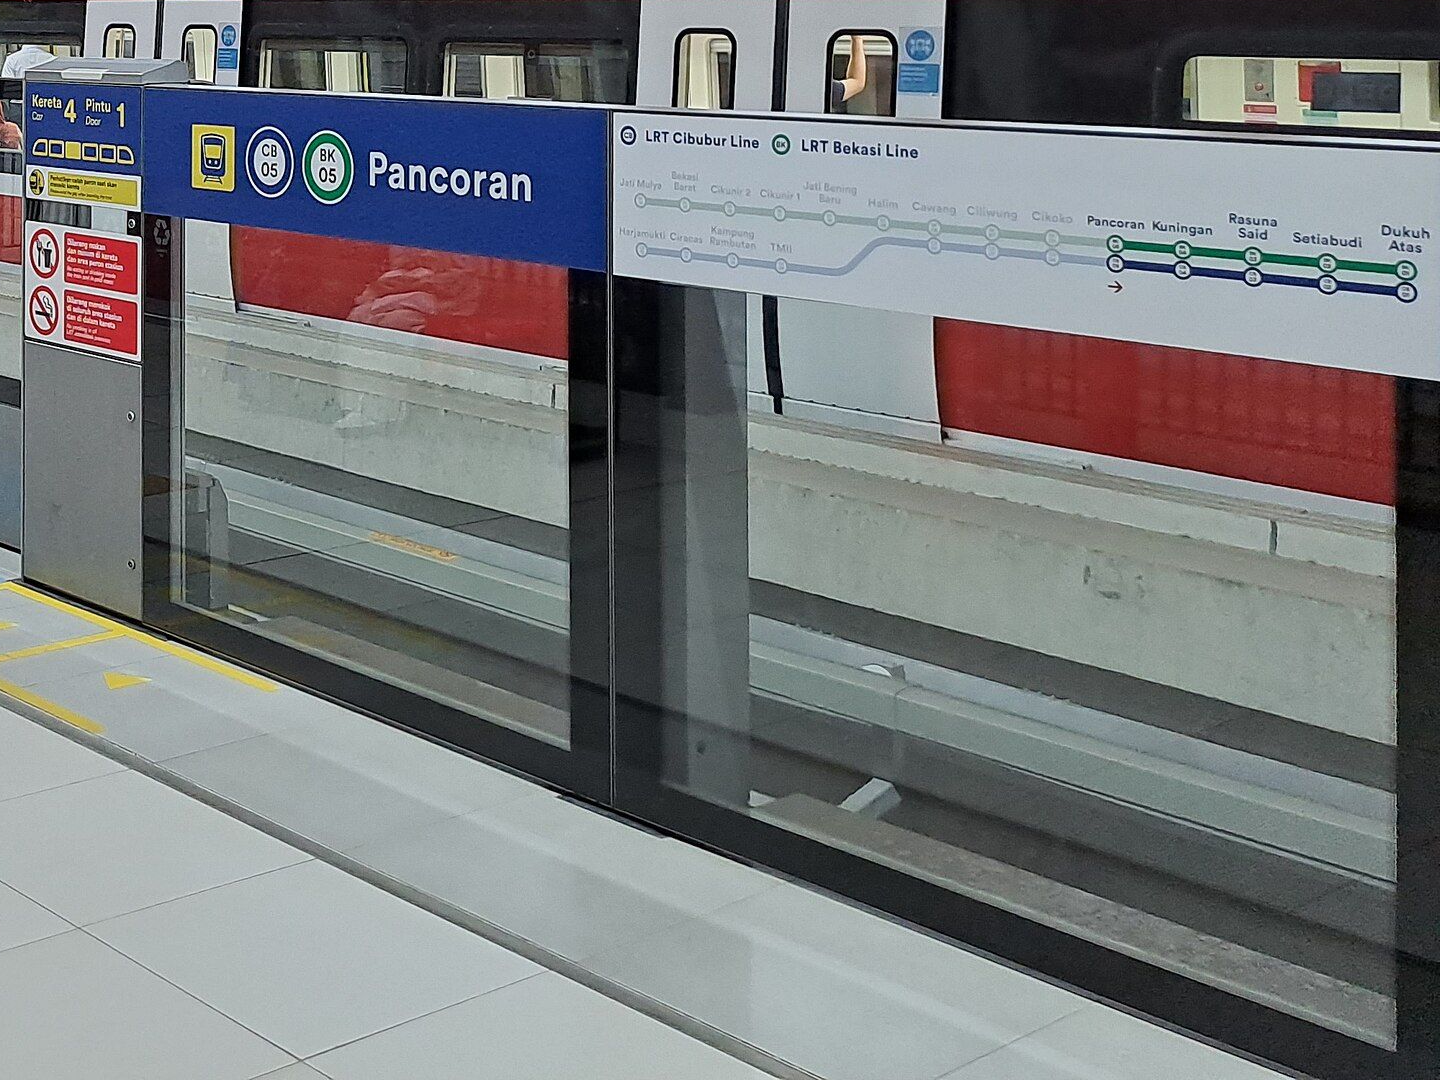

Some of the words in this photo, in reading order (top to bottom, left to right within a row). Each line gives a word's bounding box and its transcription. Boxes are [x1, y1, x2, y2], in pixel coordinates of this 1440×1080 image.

[32, 94, 62, 109] Kereta
[64, 99, 77, 123] 4
[85, 98, 111, 113] Pintu
[116, 102, 125, 128] 1
[32, 111, 44, 121] Car
[85, 115, 102, 126] Door
[262, 143, 278, 158] CB
[645, 130, 669, 143] LRT
[673, 131, 727, 147] Cibubur
[730, 135, 760, 149] Line
[776, 140, 786, 148] BK
[801, 139, 828, 153] LRT
[833, 140, 881, 157] Bekasi
[886, 143, 919, 159] Line
[320, 148, 335, 163] BK
[261, 162, 278, 178] 05
[318, 167, 337, 184] 05
[368, 151, 532, 203] Pancoran
[671, 171, 699, 181] Bekasi
[620, 178, 635, 188] Jati
[636, 179, 662, 191] Mulya
[673, 182, 696, 192] Barat
[710, 184, 743, 197] Cikunir
[745, 188, 751, 197] 2
[803, 181, 821, 191] Jati
[823, 182, 858, 196] Bening
[759, 188, 795, 200] Cikunir
[796, 192, 801, 201] 1
[818, 193, 841, 205] Baru
[867, 198, 899, 209] Halim
[911, 201, 957, 216] Cawang
[966, 205, 1018, 221] Ciliwung
[1031, 210, 1073, 224] Cikoko
[1228, 212, 1278, 228] Rasuna
[1087, 215, 1145, 230] Pancoran
[1152, 220, 1214, 237] Kuningan
[619, 227, 666, 241] Harjamukti
[669, 232, 703, 244] Ciracas
[710, 226, 755, 240] Kampung
[1238, 227, 1268, 241] Said
[1380, 224, 1430, 240] Dukuh
[710, 236, 757, 251] Rambutan
[1292, 231, 1363, 249] Setiabudi
[1388, 239, 1423, 254] Atas
